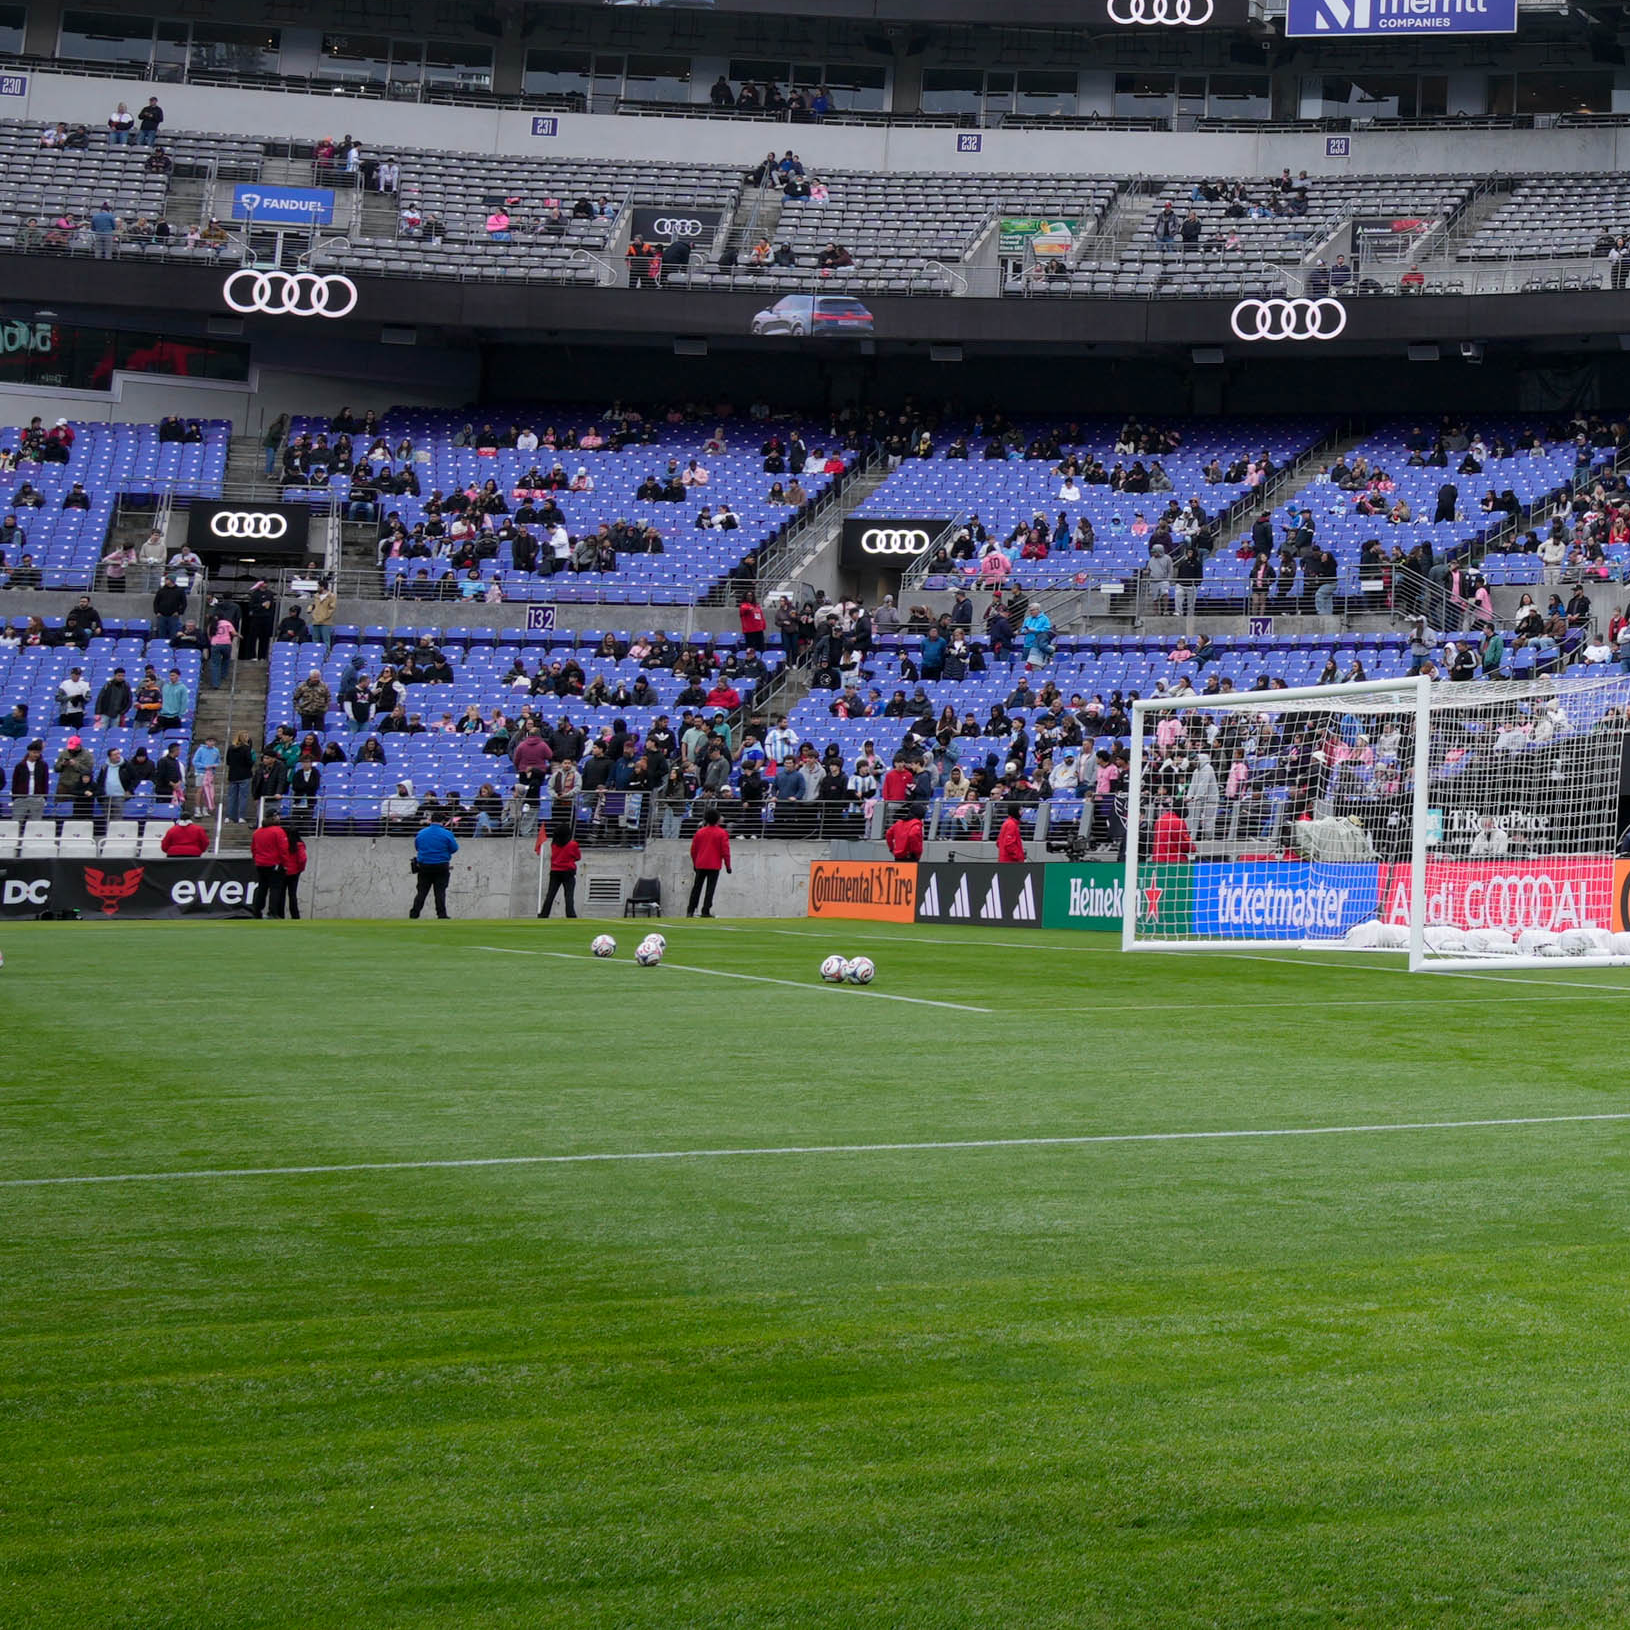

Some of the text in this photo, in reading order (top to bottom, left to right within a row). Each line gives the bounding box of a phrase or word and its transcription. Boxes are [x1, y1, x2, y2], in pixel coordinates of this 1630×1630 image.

[1378, 17, 1451, 28] COMPANIES
[2, 77, 21, 94] 230
[536, 119, 553, 134] 231
[961, 134, 977, 149] 232
[1330, 139, 1345, 154] 233
[263, 198, 325, 212] FANDUEL
[989, 557, 1000, 570] 10
[529, 608, 553, 629] 132
[811, 865, 913, 913] Continental Tire
[1069, 877, 1147, 920] Heinekn
[1218, 876, 1349, 928] ticketmaster
[1390, 881, 1454, 926] Adi
